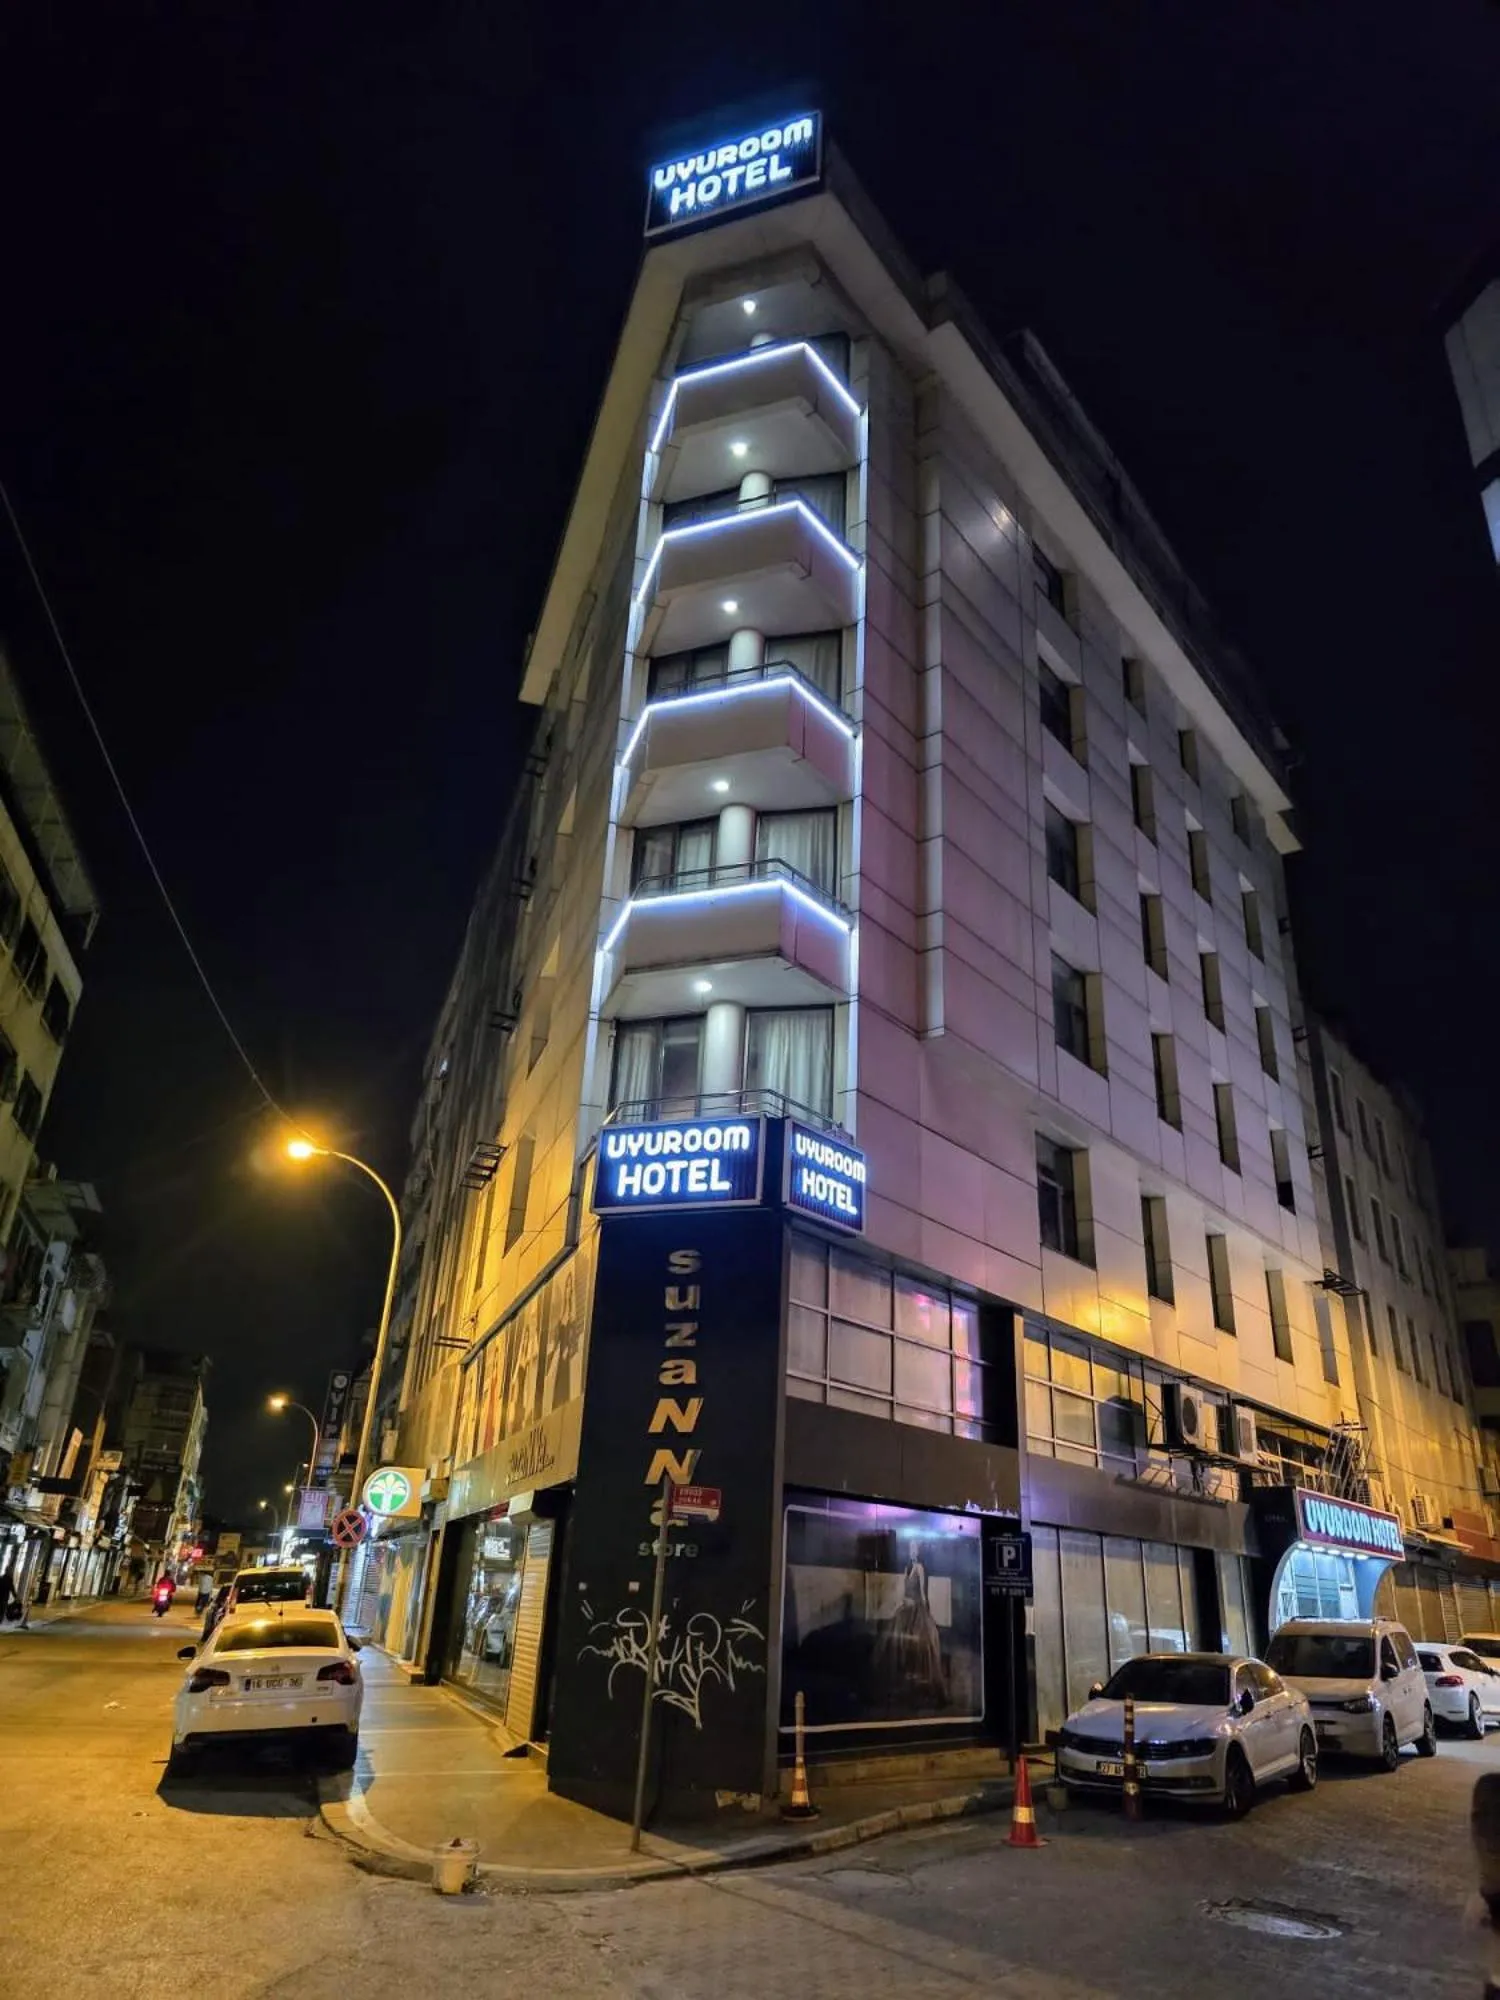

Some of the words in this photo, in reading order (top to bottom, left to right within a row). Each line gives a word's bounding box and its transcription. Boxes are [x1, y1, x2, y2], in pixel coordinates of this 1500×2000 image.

[654, 117, 813, 189] UYUROOM
[670, 154, 792, 215] HOTEL
[607, 1125, 750, 1159] UYUROOM
[795, 1133, 866, 1183] UYUROOM
[616, 1158, 732, 1197] HOTEL
[802, 1168, 858, 1216] HOTEL
[638, 1538, 699, 1557] store
[1305, 1498, 1372, 1544] UYUROOM
[1371, 1516, 1404, 1552] HOTEL
[1002, 1545, 1016, 1568] P
